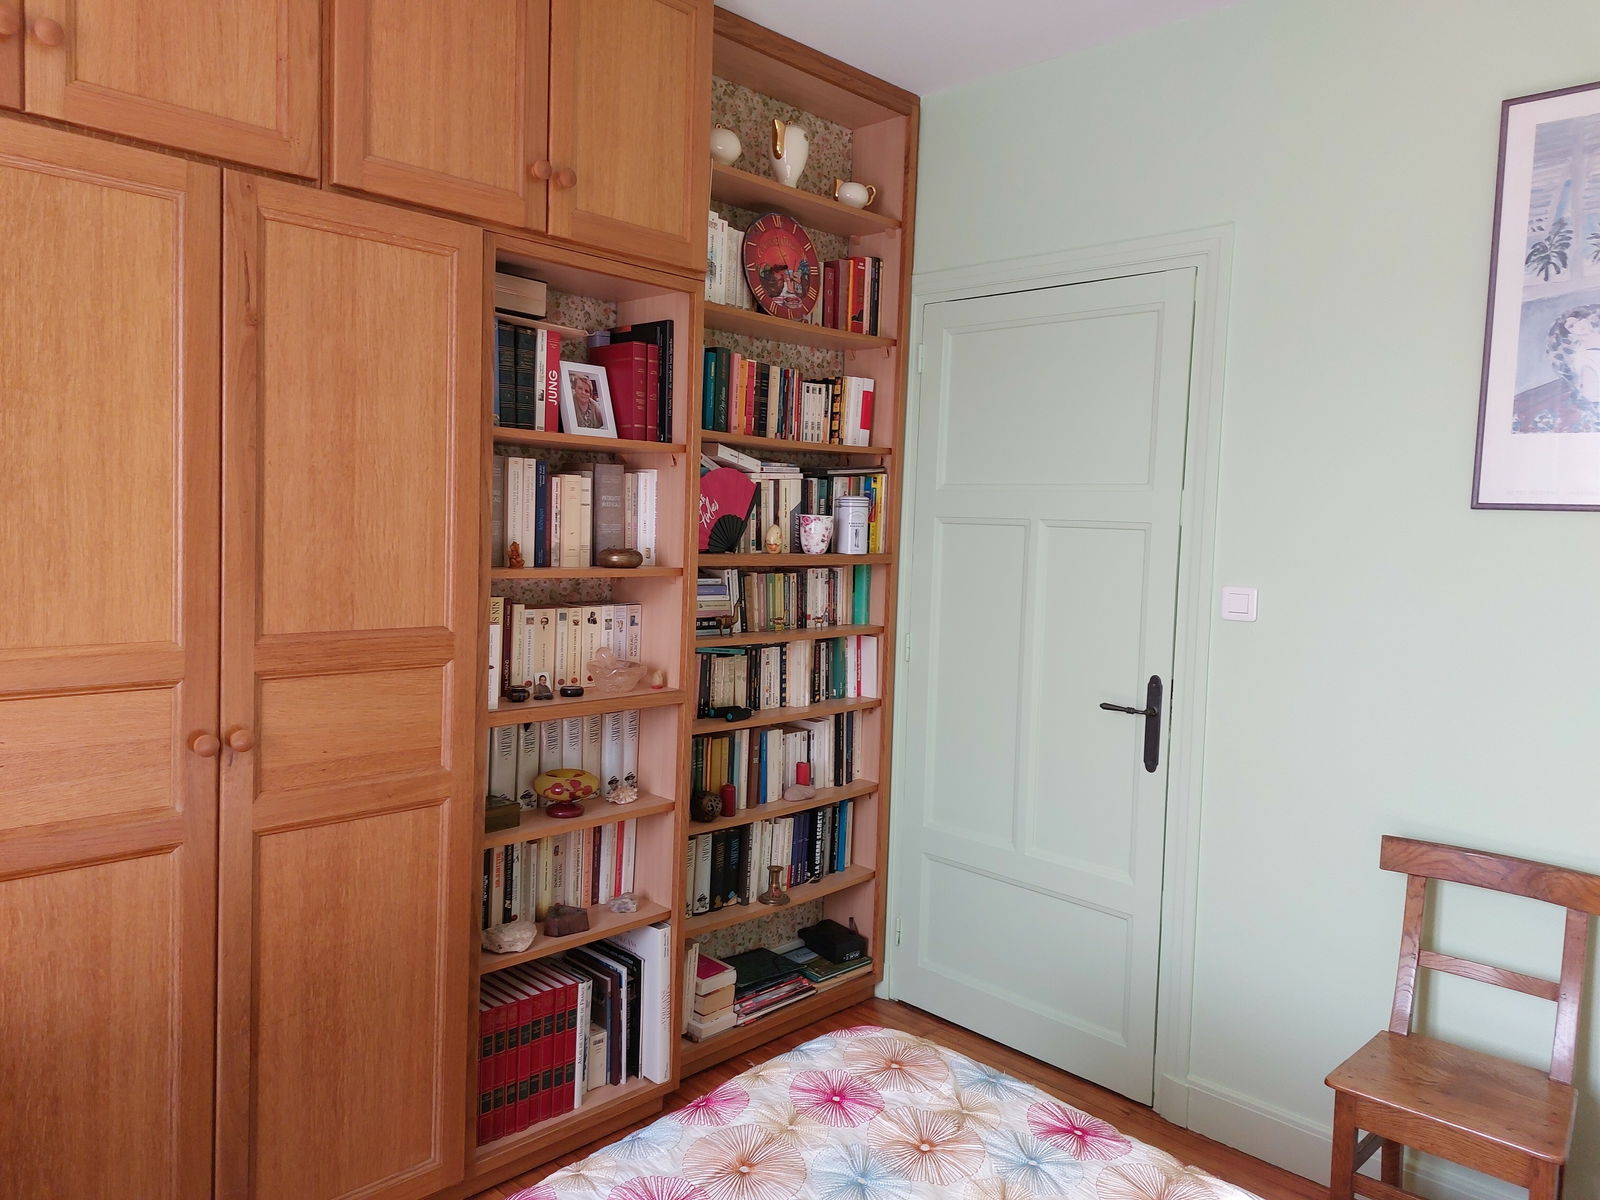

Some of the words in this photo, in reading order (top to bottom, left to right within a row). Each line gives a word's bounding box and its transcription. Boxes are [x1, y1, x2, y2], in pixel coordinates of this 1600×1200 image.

[548, 369, 558, 406] JUNG
[492, 601, 500, 615] NIN
[501, 727, 512, 756] SIMENON
[547, 721, 558, 751] SIMENON
[568, 718, 579, 747] SIMENON
[611, 713, 621, 741] SIMENON
[814, 865, 820, 874] LA
